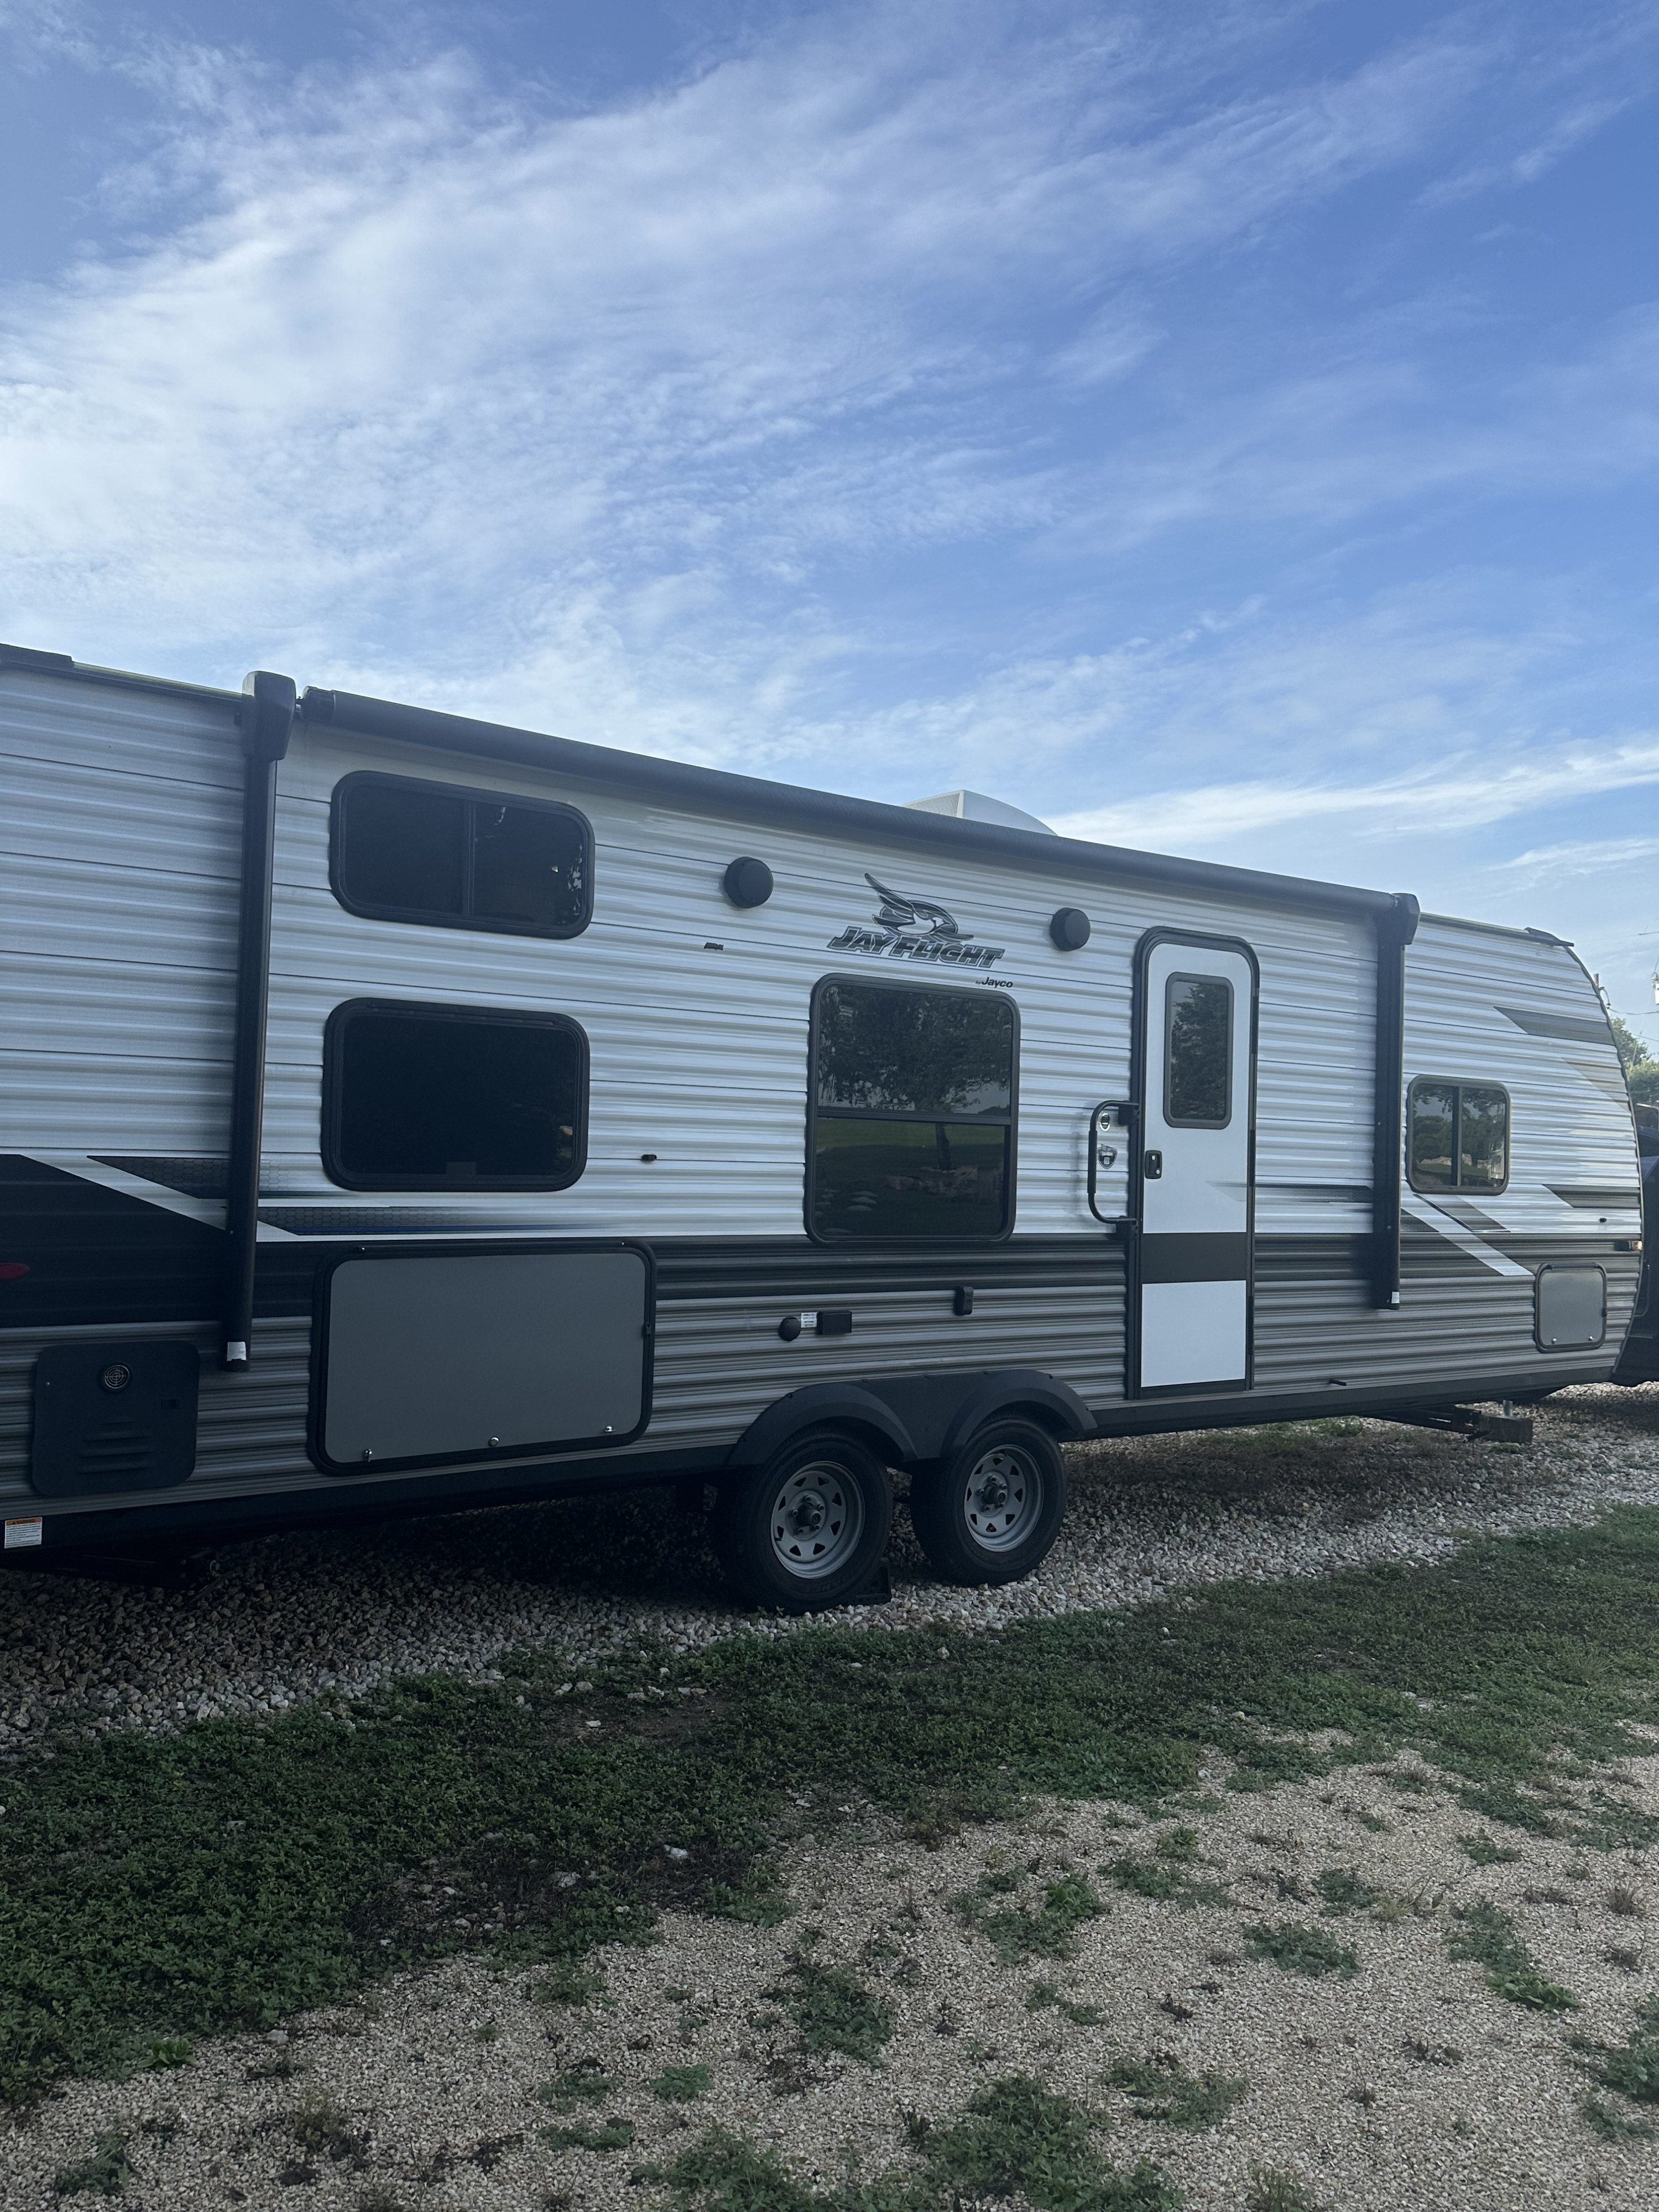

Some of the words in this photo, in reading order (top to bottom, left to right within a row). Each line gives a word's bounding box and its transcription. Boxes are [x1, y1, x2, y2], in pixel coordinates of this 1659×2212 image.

[827, 926, 894, 954] JAY
[888, 936, 1005, 968] FLIGHT
[981, 977, 1013, 988] Jayco
